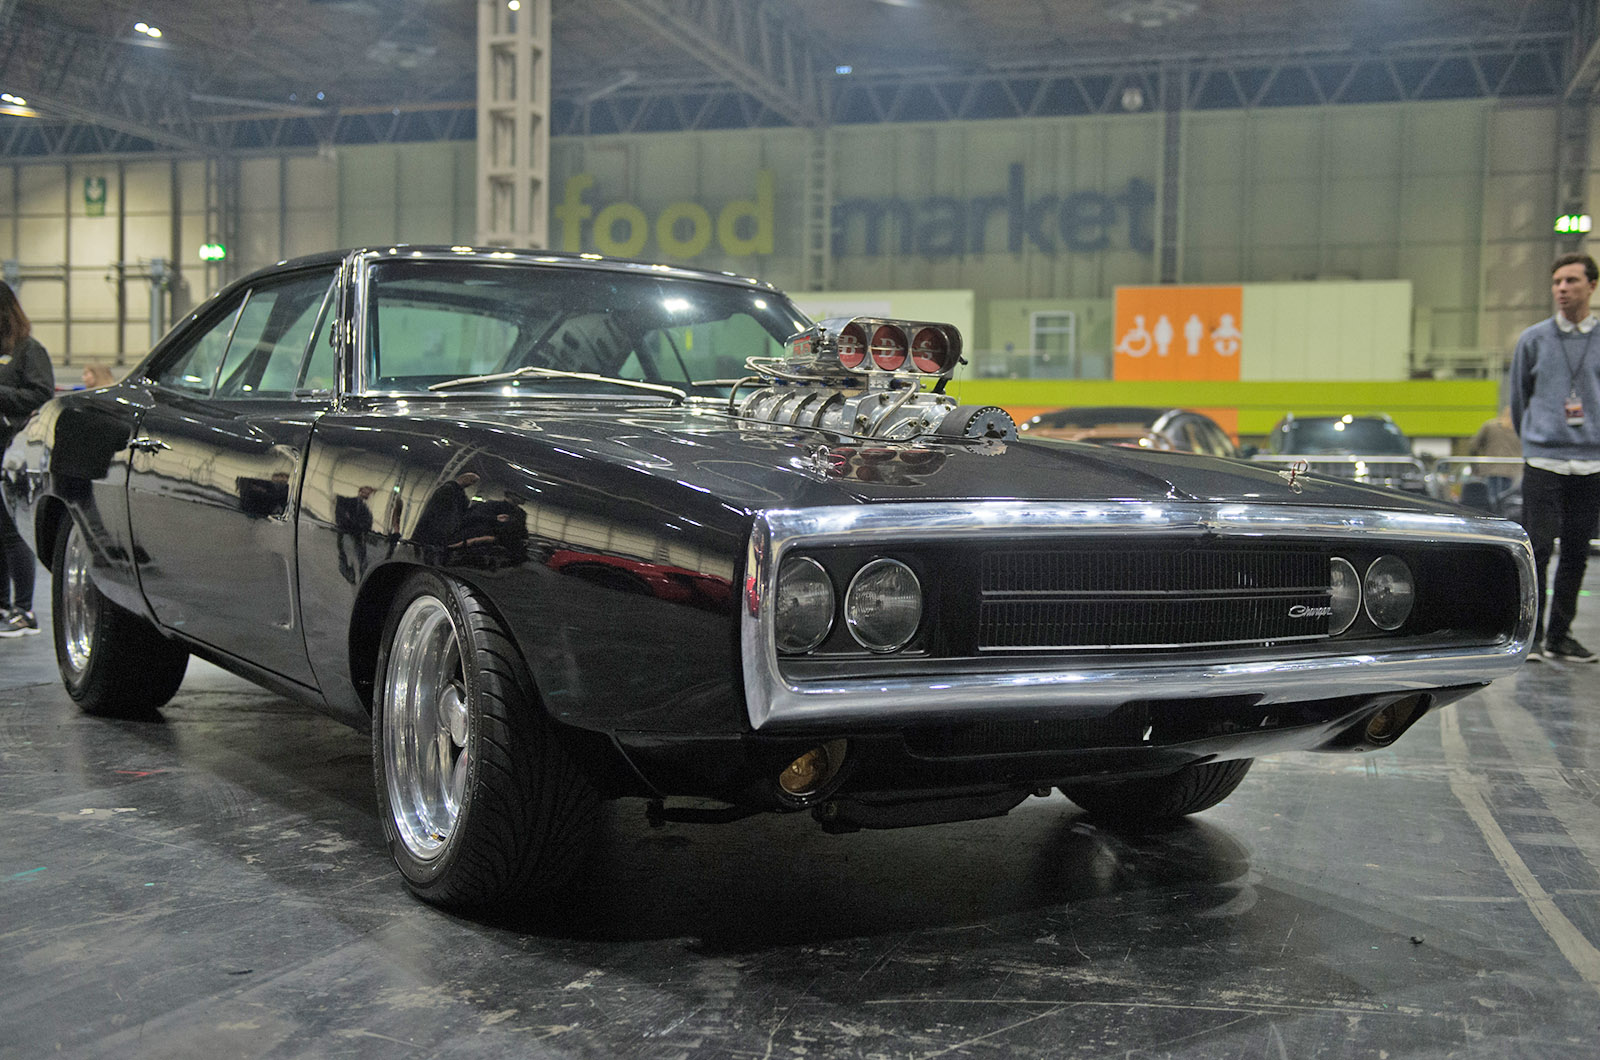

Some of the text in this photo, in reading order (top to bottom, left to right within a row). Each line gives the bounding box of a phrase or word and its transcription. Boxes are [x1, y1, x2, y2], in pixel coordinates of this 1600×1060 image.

[555, 162, 1155, 262] food market
[1288, 605, 1333, 620] Charger
